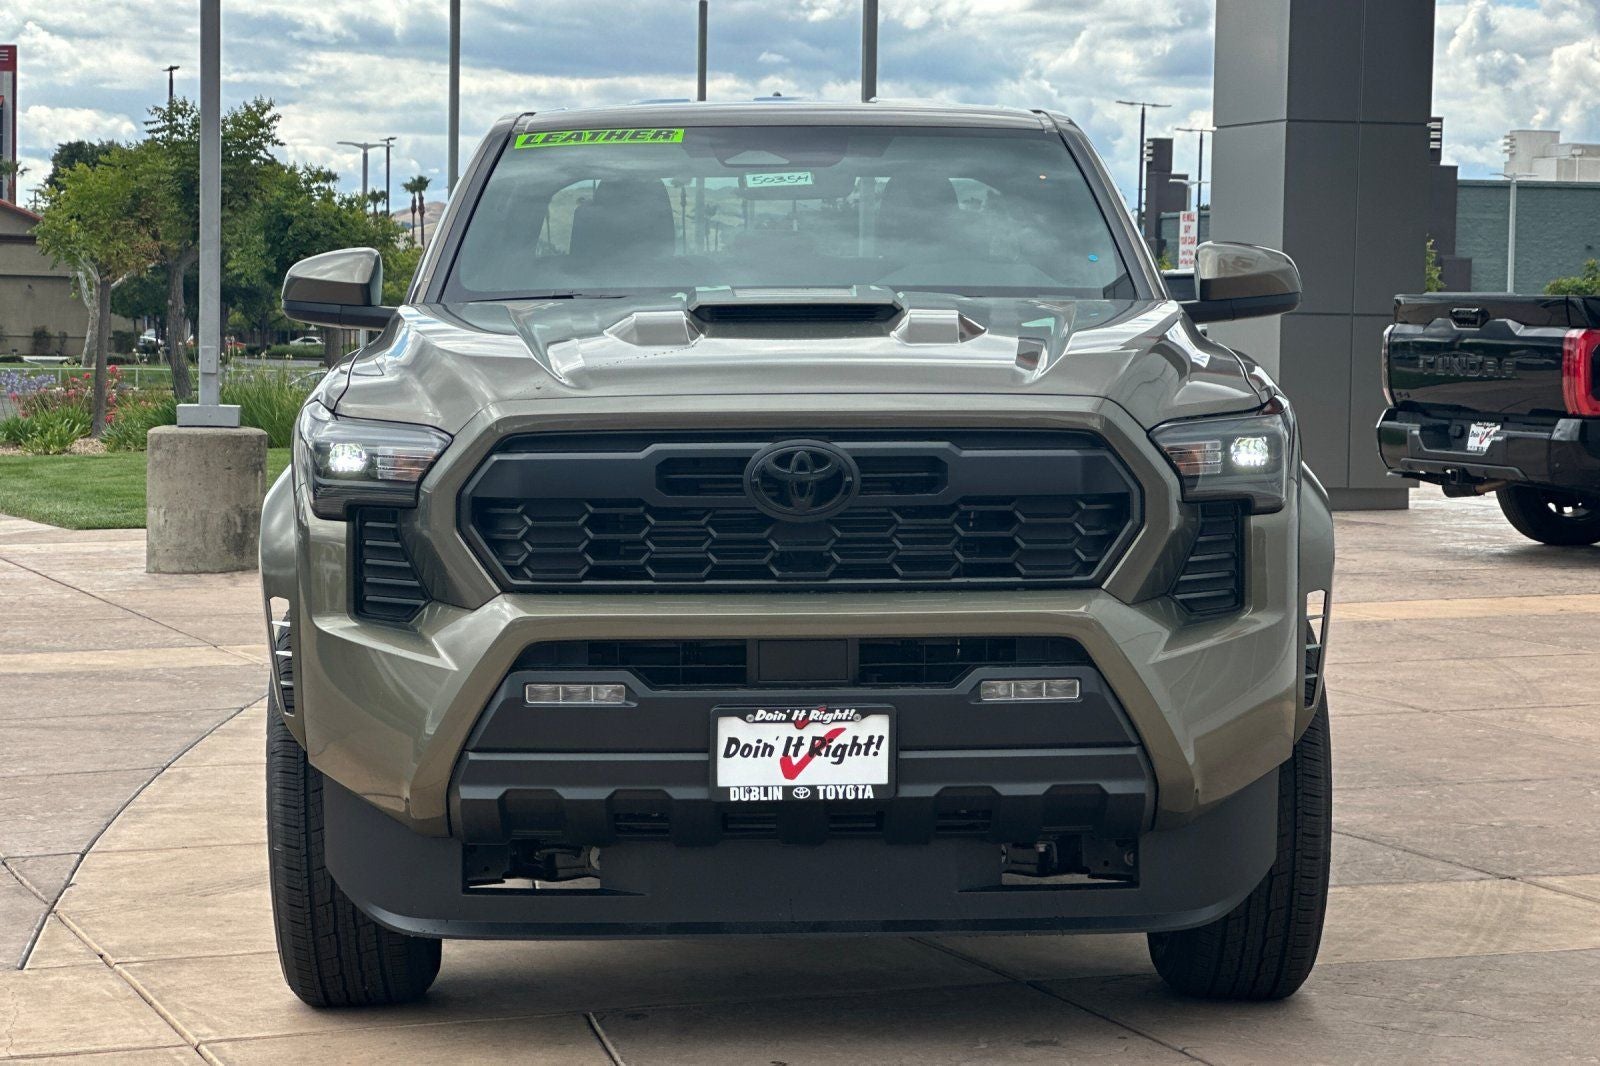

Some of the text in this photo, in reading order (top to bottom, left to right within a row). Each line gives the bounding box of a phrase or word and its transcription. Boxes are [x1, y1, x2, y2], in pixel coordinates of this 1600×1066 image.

[521, 128, 677, 145] LEATHER
[754, 708, 856, 724] Doin' It Right!
[722, 734, 885, 766] Doin' It Right!
[729, 784, 875, 801] DUBLIN TOYOTA
